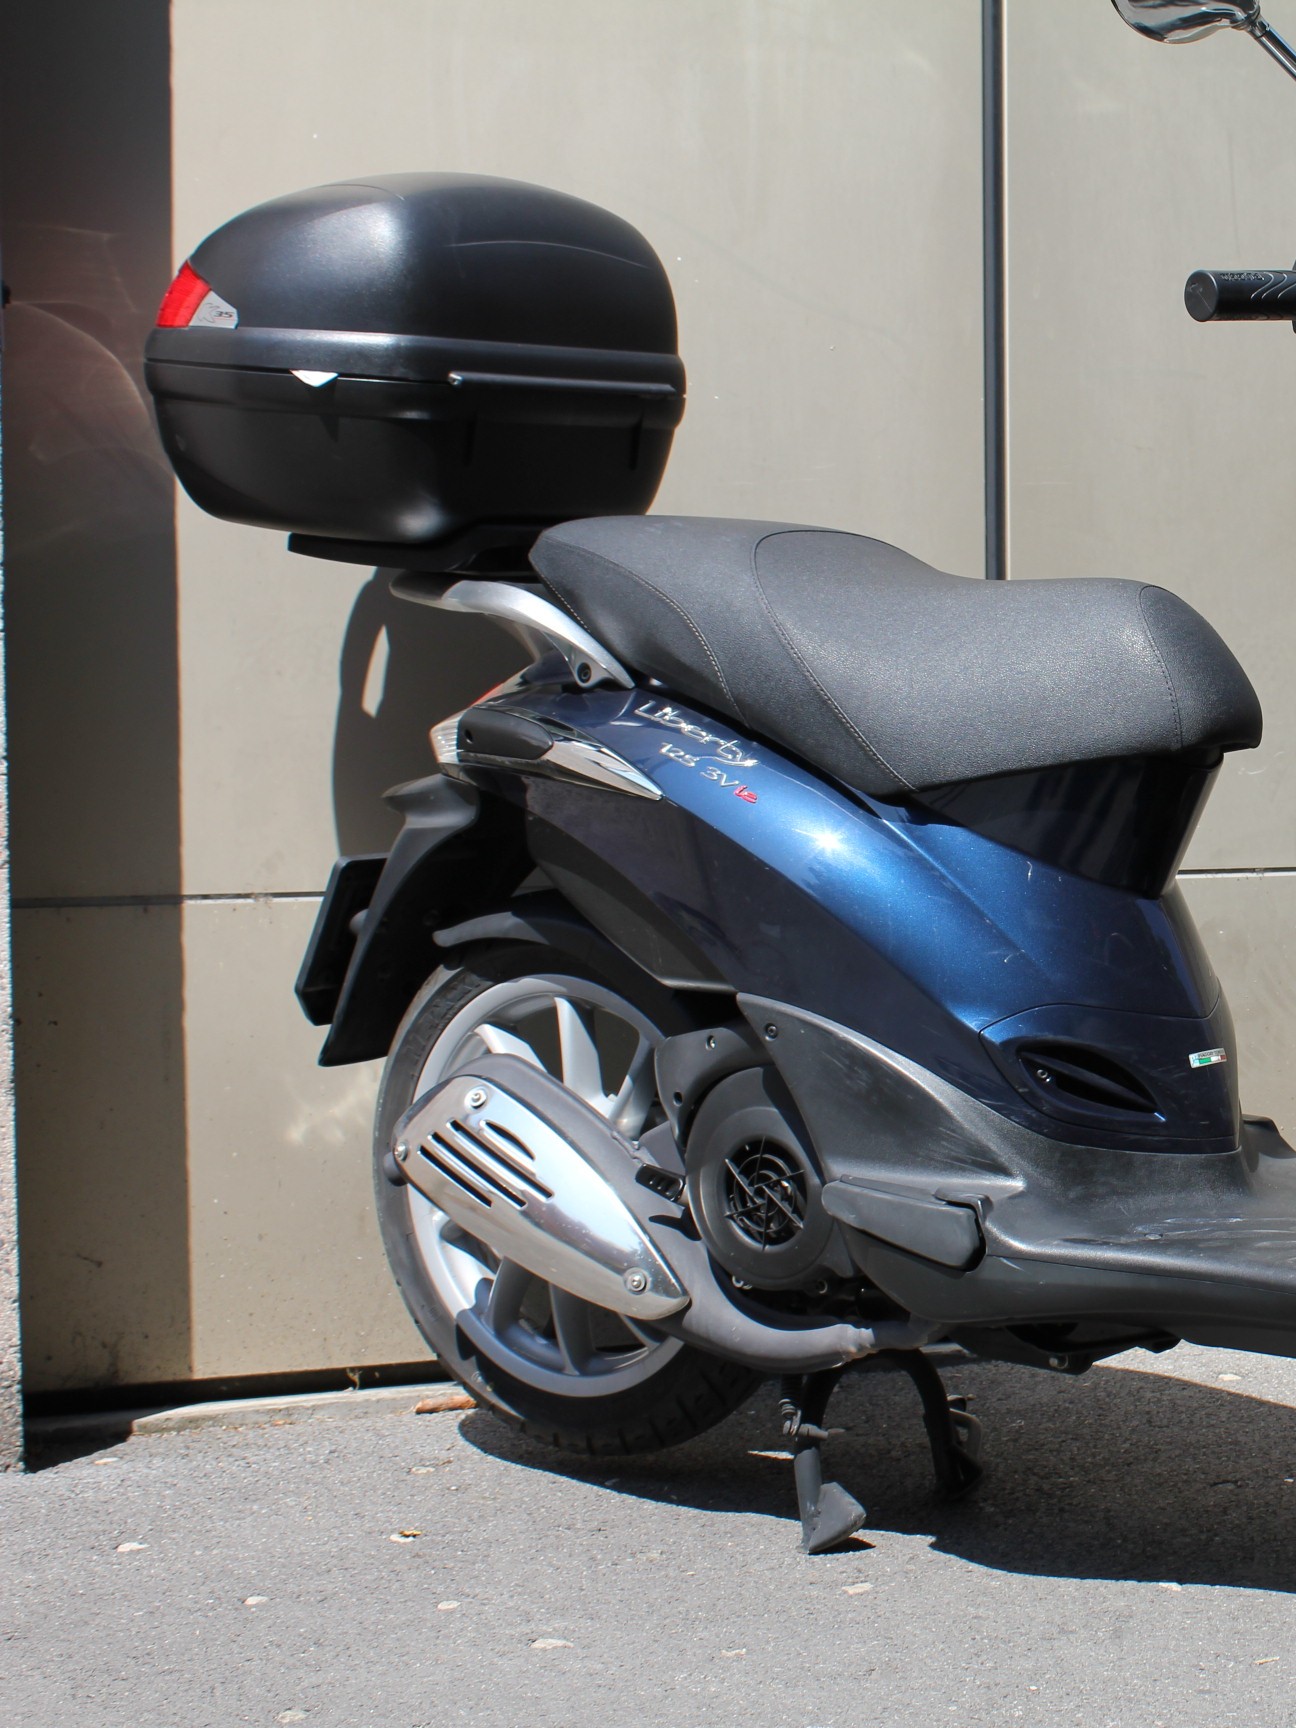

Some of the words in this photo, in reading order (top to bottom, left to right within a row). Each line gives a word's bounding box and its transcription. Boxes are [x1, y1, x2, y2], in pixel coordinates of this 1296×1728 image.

[634, 700, 759, 767] Liberty
[659, 742, 696, 768] 125
[700, 766, 739, 787] 3V
